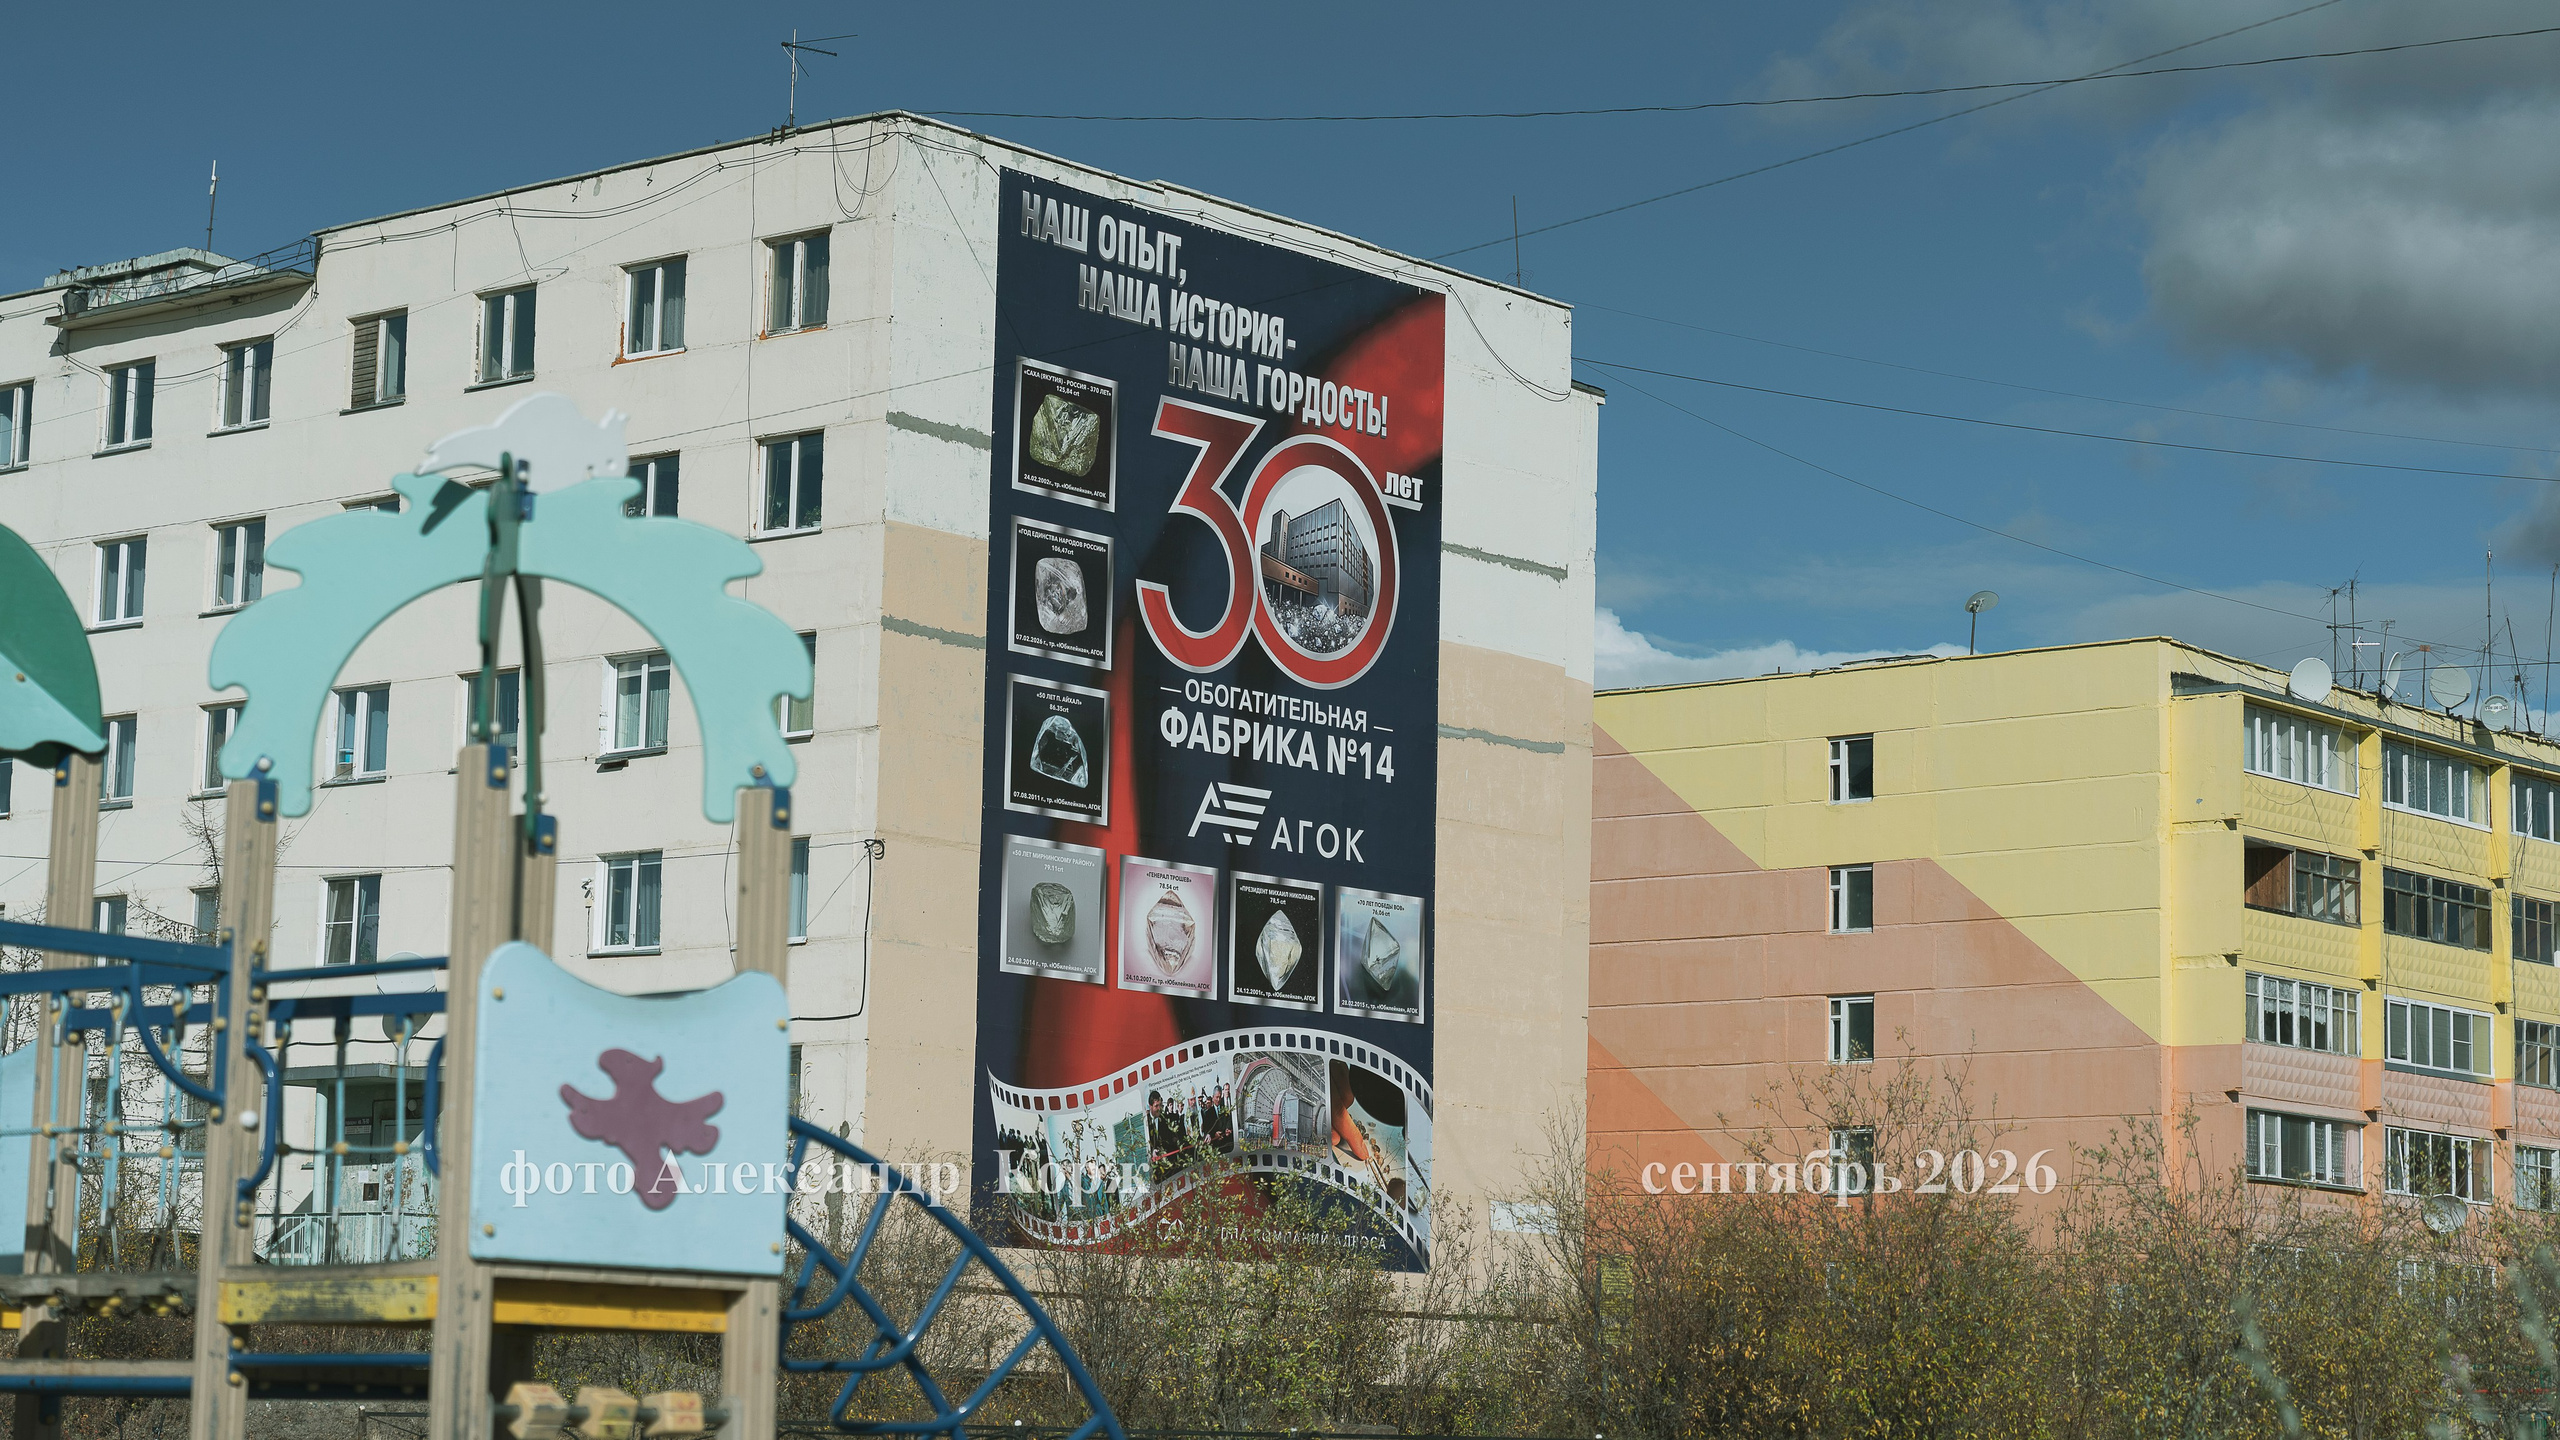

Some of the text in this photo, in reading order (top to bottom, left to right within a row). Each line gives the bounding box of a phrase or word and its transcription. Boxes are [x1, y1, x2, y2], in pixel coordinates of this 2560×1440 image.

[1020, 190, 1187, 286] НАШ ОПЫТ,
[1078, 263, 1162, 330] НАША
[1066, 380, 1087, 390] РОССИЯ
[1090, 386, 1099, 394] 370
[1167, 341, 1388, 439] НАША ГОРДОСТЬ!
[1094, 490, 1106, 498] АГОК
[1384, 471, 1424, 502] лет
[1032, 530, 1058, 542] ЕДИНСТВА
[1059, 537, 1082, 548] НАРОДОВ
[1135, 394, 1400, 690] 30
[1091, 649, 1104, 657] АГОК
[1184, 678, 1367, 733] ОБОГАТИТЕЛЬНАЯ
[1160, 706, 1395, 784] ФАБРИКА №14
[1032, 852, 1071, 864] МИРНИНСКОМУ
[1270, 816, 1365, 863] АГОК
[1197, 982, 1210, 990] АГОК
